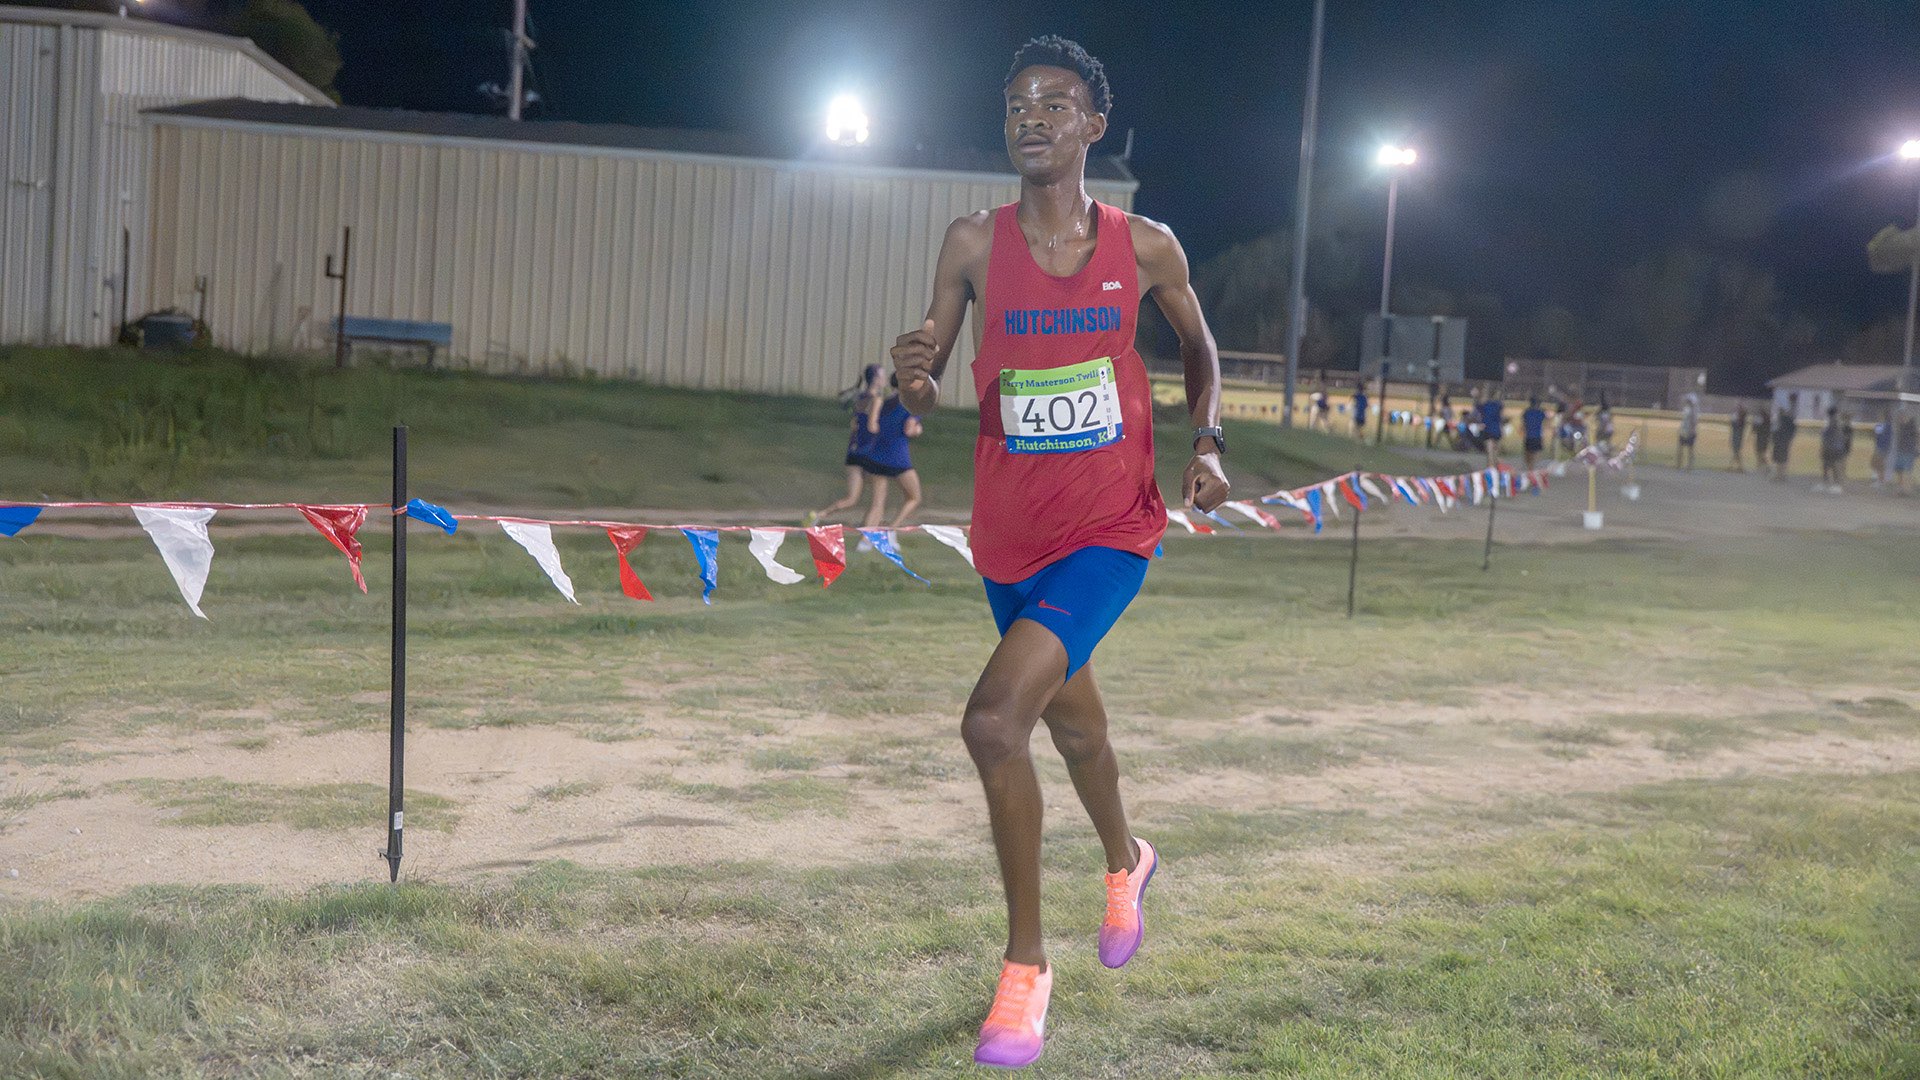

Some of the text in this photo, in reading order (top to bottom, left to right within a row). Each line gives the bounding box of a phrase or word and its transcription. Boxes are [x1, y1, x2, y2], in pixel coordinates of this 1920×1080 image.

[1004, 307, 1121, 335] HUTCHINSON
[1025, 377, 1075, 388] Masterson
[1022, 391, 1100, 432] 402
[1015, 437, 1096, 451] Hutchinson,
